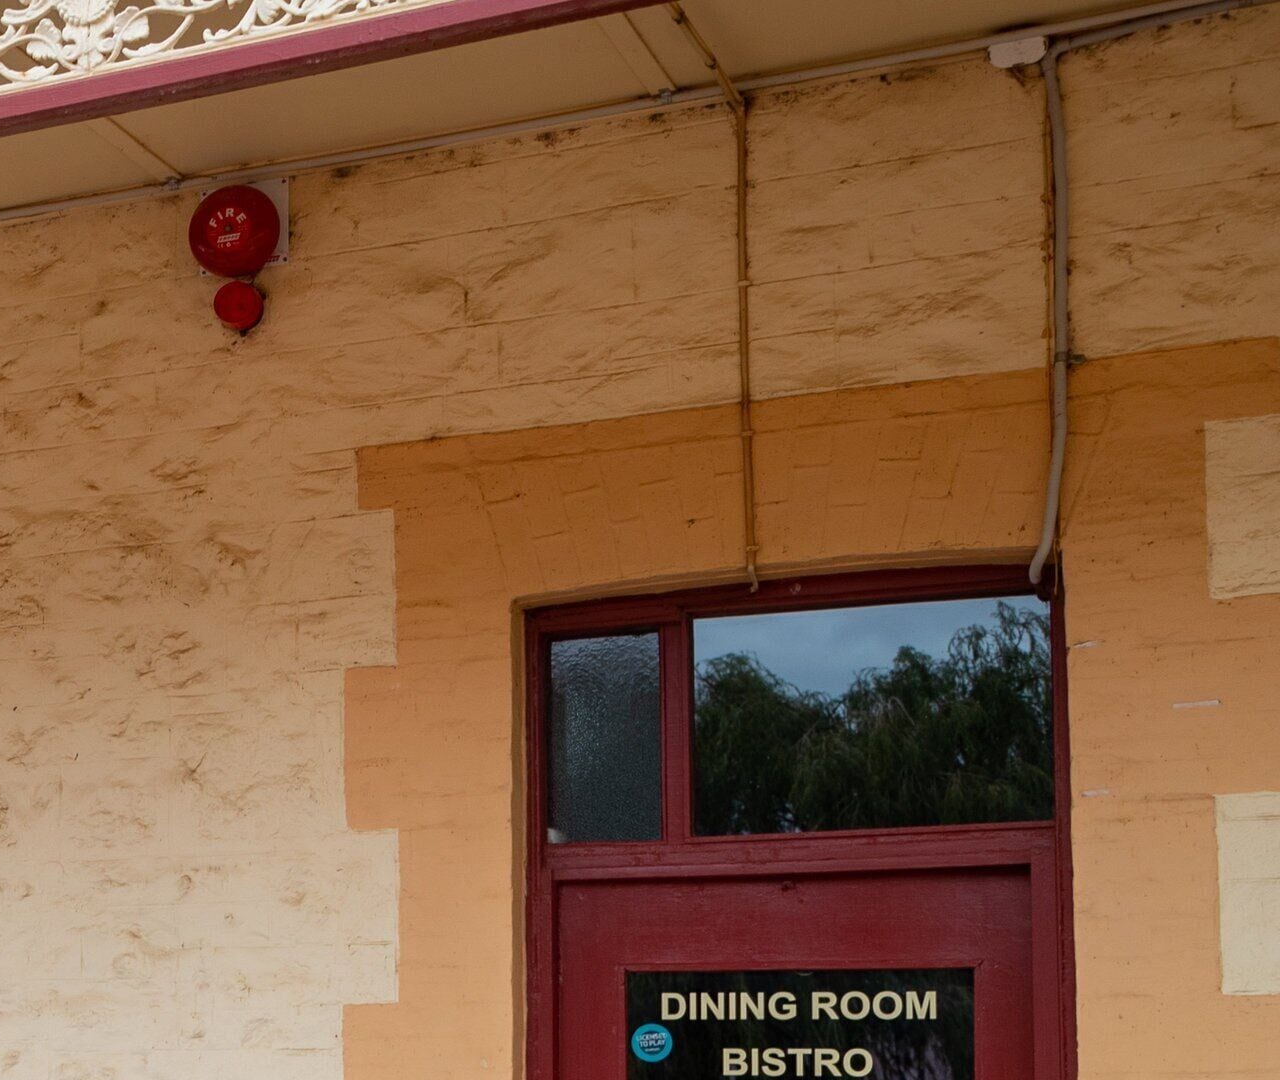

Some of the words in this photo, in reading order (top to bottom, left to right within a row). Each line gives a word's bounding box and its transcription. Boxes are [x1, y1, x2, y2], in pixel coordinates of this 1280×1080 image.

[209, 208, 247, 228] FIRE
[660, 991, 798, 1021] DINING
[811, 990, 938, 1020] ROOM
[723, 1048, 874, 1078] BISTRO
